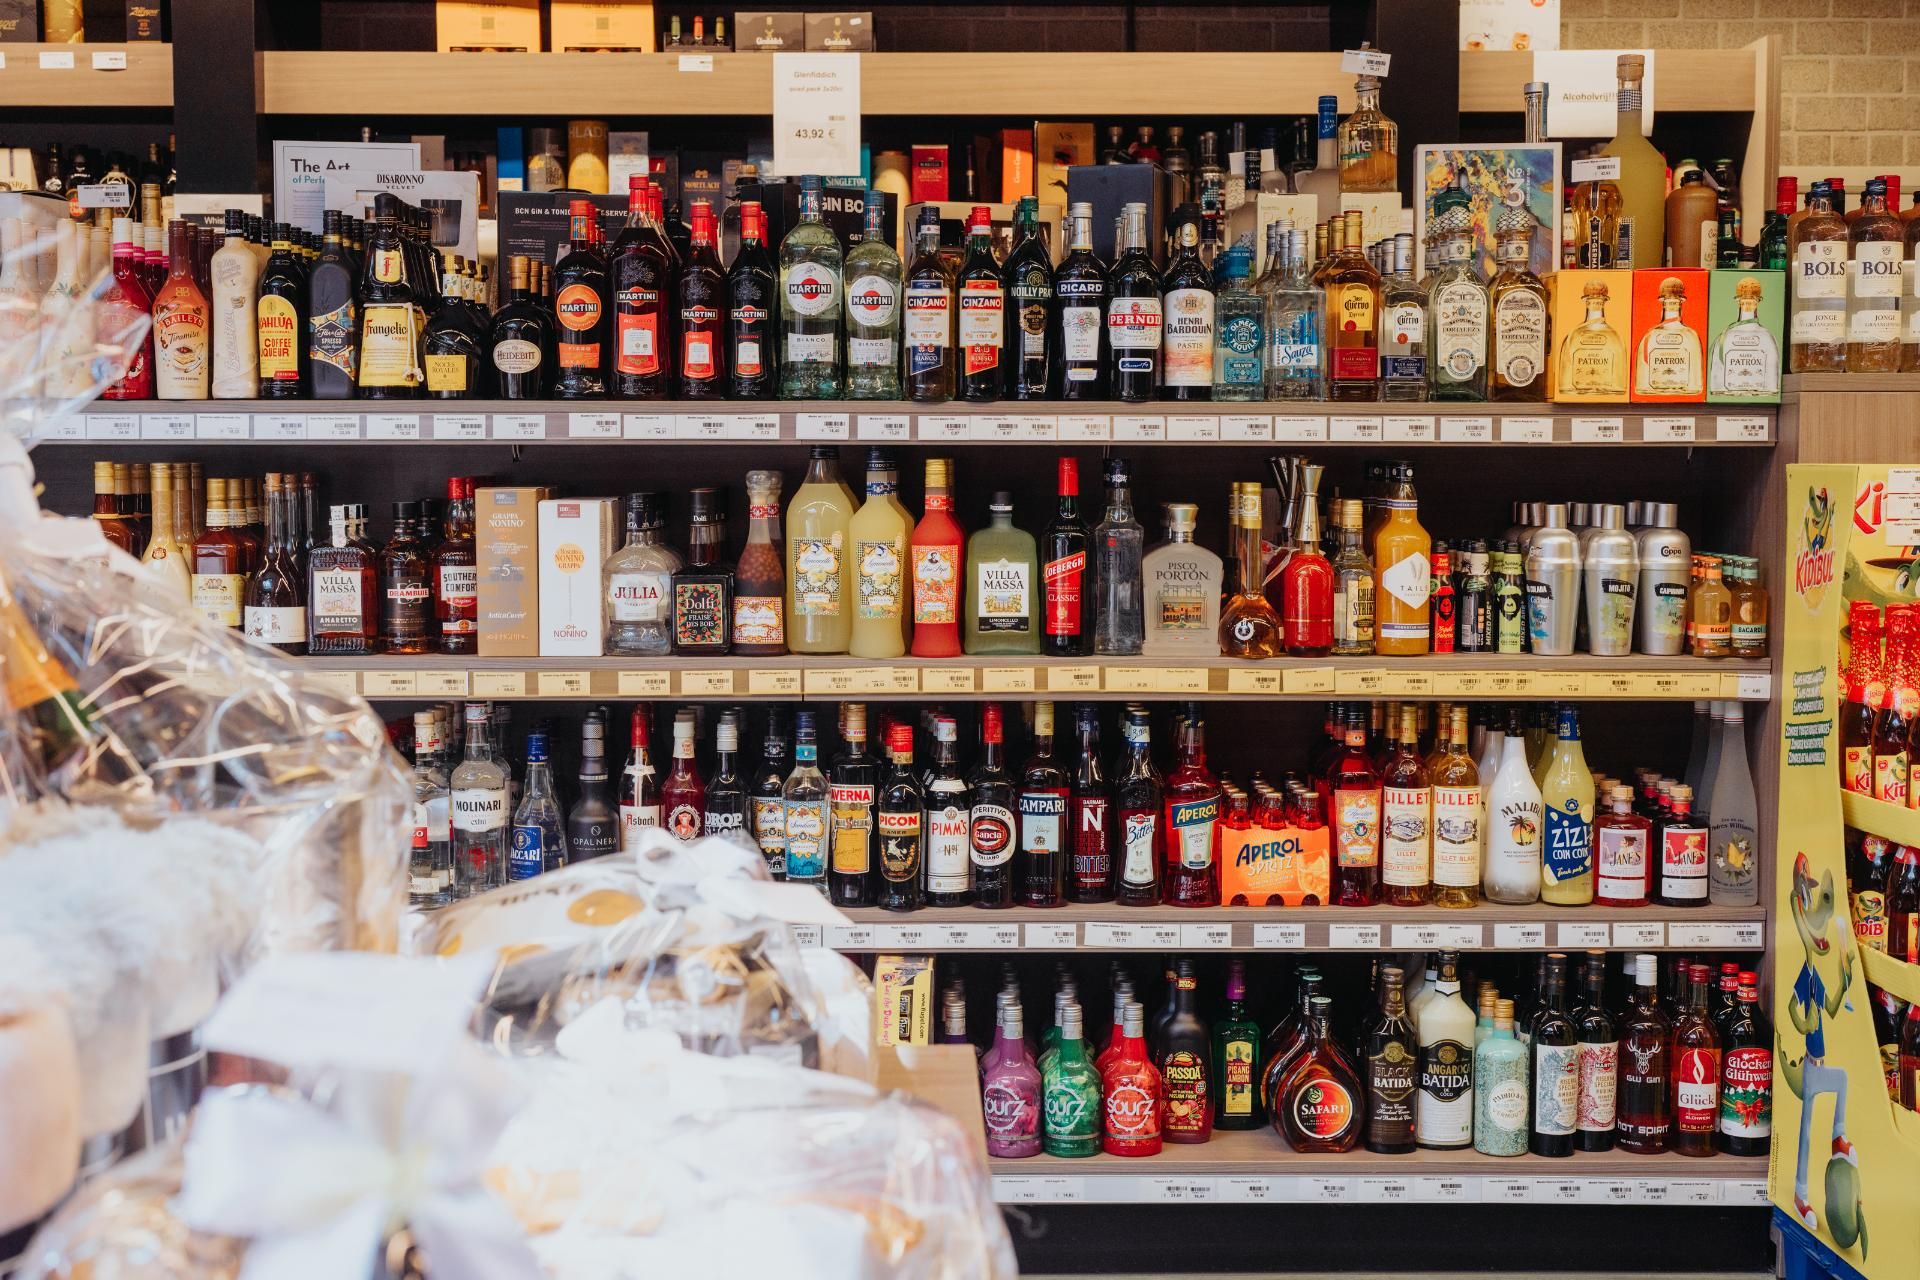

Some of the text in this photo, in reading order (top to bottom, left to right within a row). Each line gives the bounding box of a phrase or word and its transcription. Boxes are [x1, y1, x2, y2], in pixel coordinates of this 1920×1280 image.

[795, 129, 824, 139] 43,92
[290, 158, 321, 173] The
[376, 174, 425, 185] DISARONNO
[684, 181, 720, 190] MORTLACH
[1506, 178, 1525, 207] 3
[844, 198, 865, 213] BO
[515, 207, 530, 216] BCN
[1803, 261, 1845, 277] BOLS
[1862, 261, 1902, 276] BOLS
[790, 284, 831, 294] MARTINI
[1011, 287, 1036, 297] NOILLY
[1060, 283, 1103, 293] RICARD
[852, 296, 892, 305] MARTINI
[908, 298, 946, 308] CINZANO
[963, 298, 1002, 308] CINZANO
[561, 304, 598, 312] MARTINI
[163, 314, 205, 328] BAILEYS
[1110, 314, 1161, 325] PERNOD
[1177, 317, 1203, 325] HENRI
[1231, 318, 1257, 332] OLMECA
[1167, 324, 1212, 334] BARDOUIN
[264, 338, 292, 347] COFFEE
[1281, 345, 1314, 364] Sauza
[1854, 480, 1889, 535] Ki
[488, 519, 525, 527] NONINO
[554, 554, 584, 562] NONINO
[501, 563, 511, 577] 5
[1046, 556, 1084, 577] COEBERGH
[1167, 562, 1198, 571] PISCO
[322, 576, 353, 585] VILLA
[986, 570, 1021, 580] VILLA
[320, 585, 356, 593] MASSA
[983, 580, 1024, 590] MASSA
[1608, 584, 1631, 593] MOJITO
[388, 589, 429, 597] DRAMBUIE
[614, 587, 658, 599] JULIA
[1047, 594, 1079, 602] CLASSIC
[684, 599, 715, 610] Dolfi
[553, 630, 588, 638] NONINO
[1386, 791, 1430, 805] LILLET
[1436, 791, 1481, 805] LILLET
[456, 800, 501, 812] MOLINARI
[1019, 799, 1065, 812] CAMPARI
[704, 812, 743, 824] DROP
[1176, 803, 1217, 824] APEROL
[626, 814, 655, 826] Asbach
[879, 815, 918, 826] PICON
[1083, 808, 1102, 831] N
[974, 830, 1003, 839] Gancia
[1126, 824, 1155, 845] Bitter
[574, 837, 617, 846] OPAL NERA
[510, 849, 541, 861] ACCARI
[1236, 837, 1304, 867] APEROL
[1552, 848, 1571, 860] COIN
[1728, 1056, 1772, 1070] Glocken
[1375, 1066, 1410, 1077] BLACK
[1725, 1069, 1772, 1081] Glühwein
[1373, 1077, 1412, 1088] BATIDA
[1422, 1073, 1470, 1088] BATIDA
[1680, 1092, 1715, 1106] Glück
[1301, 1103, 1345, 1115] SAFARI
